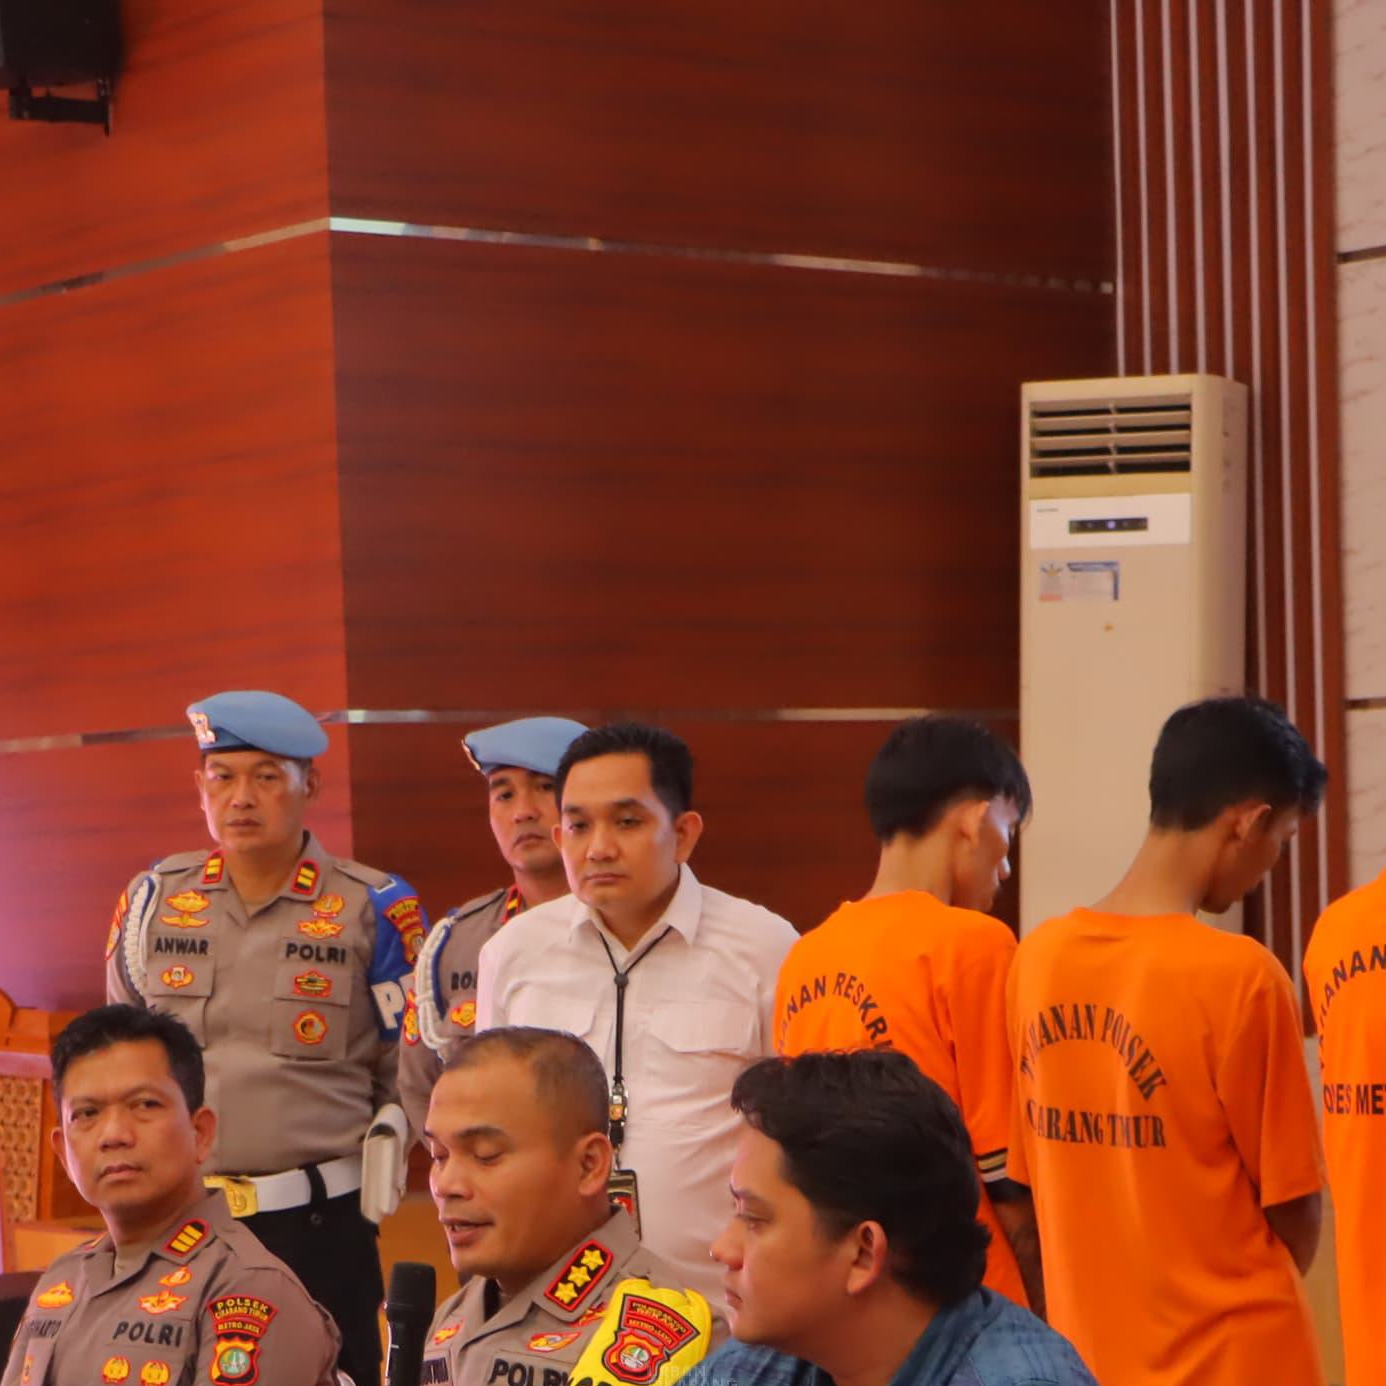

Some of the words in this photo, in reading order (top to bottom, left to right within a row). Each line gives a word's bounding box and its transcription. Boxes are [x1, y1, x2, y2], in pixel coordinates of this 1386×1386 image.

[154, 937, 209, 955] ANWAR
[285, 942, 348, 965] POLRI
[217, 1298, 269, 1313] POLSEK
[113, 1320, 184, 1348] POLRI
